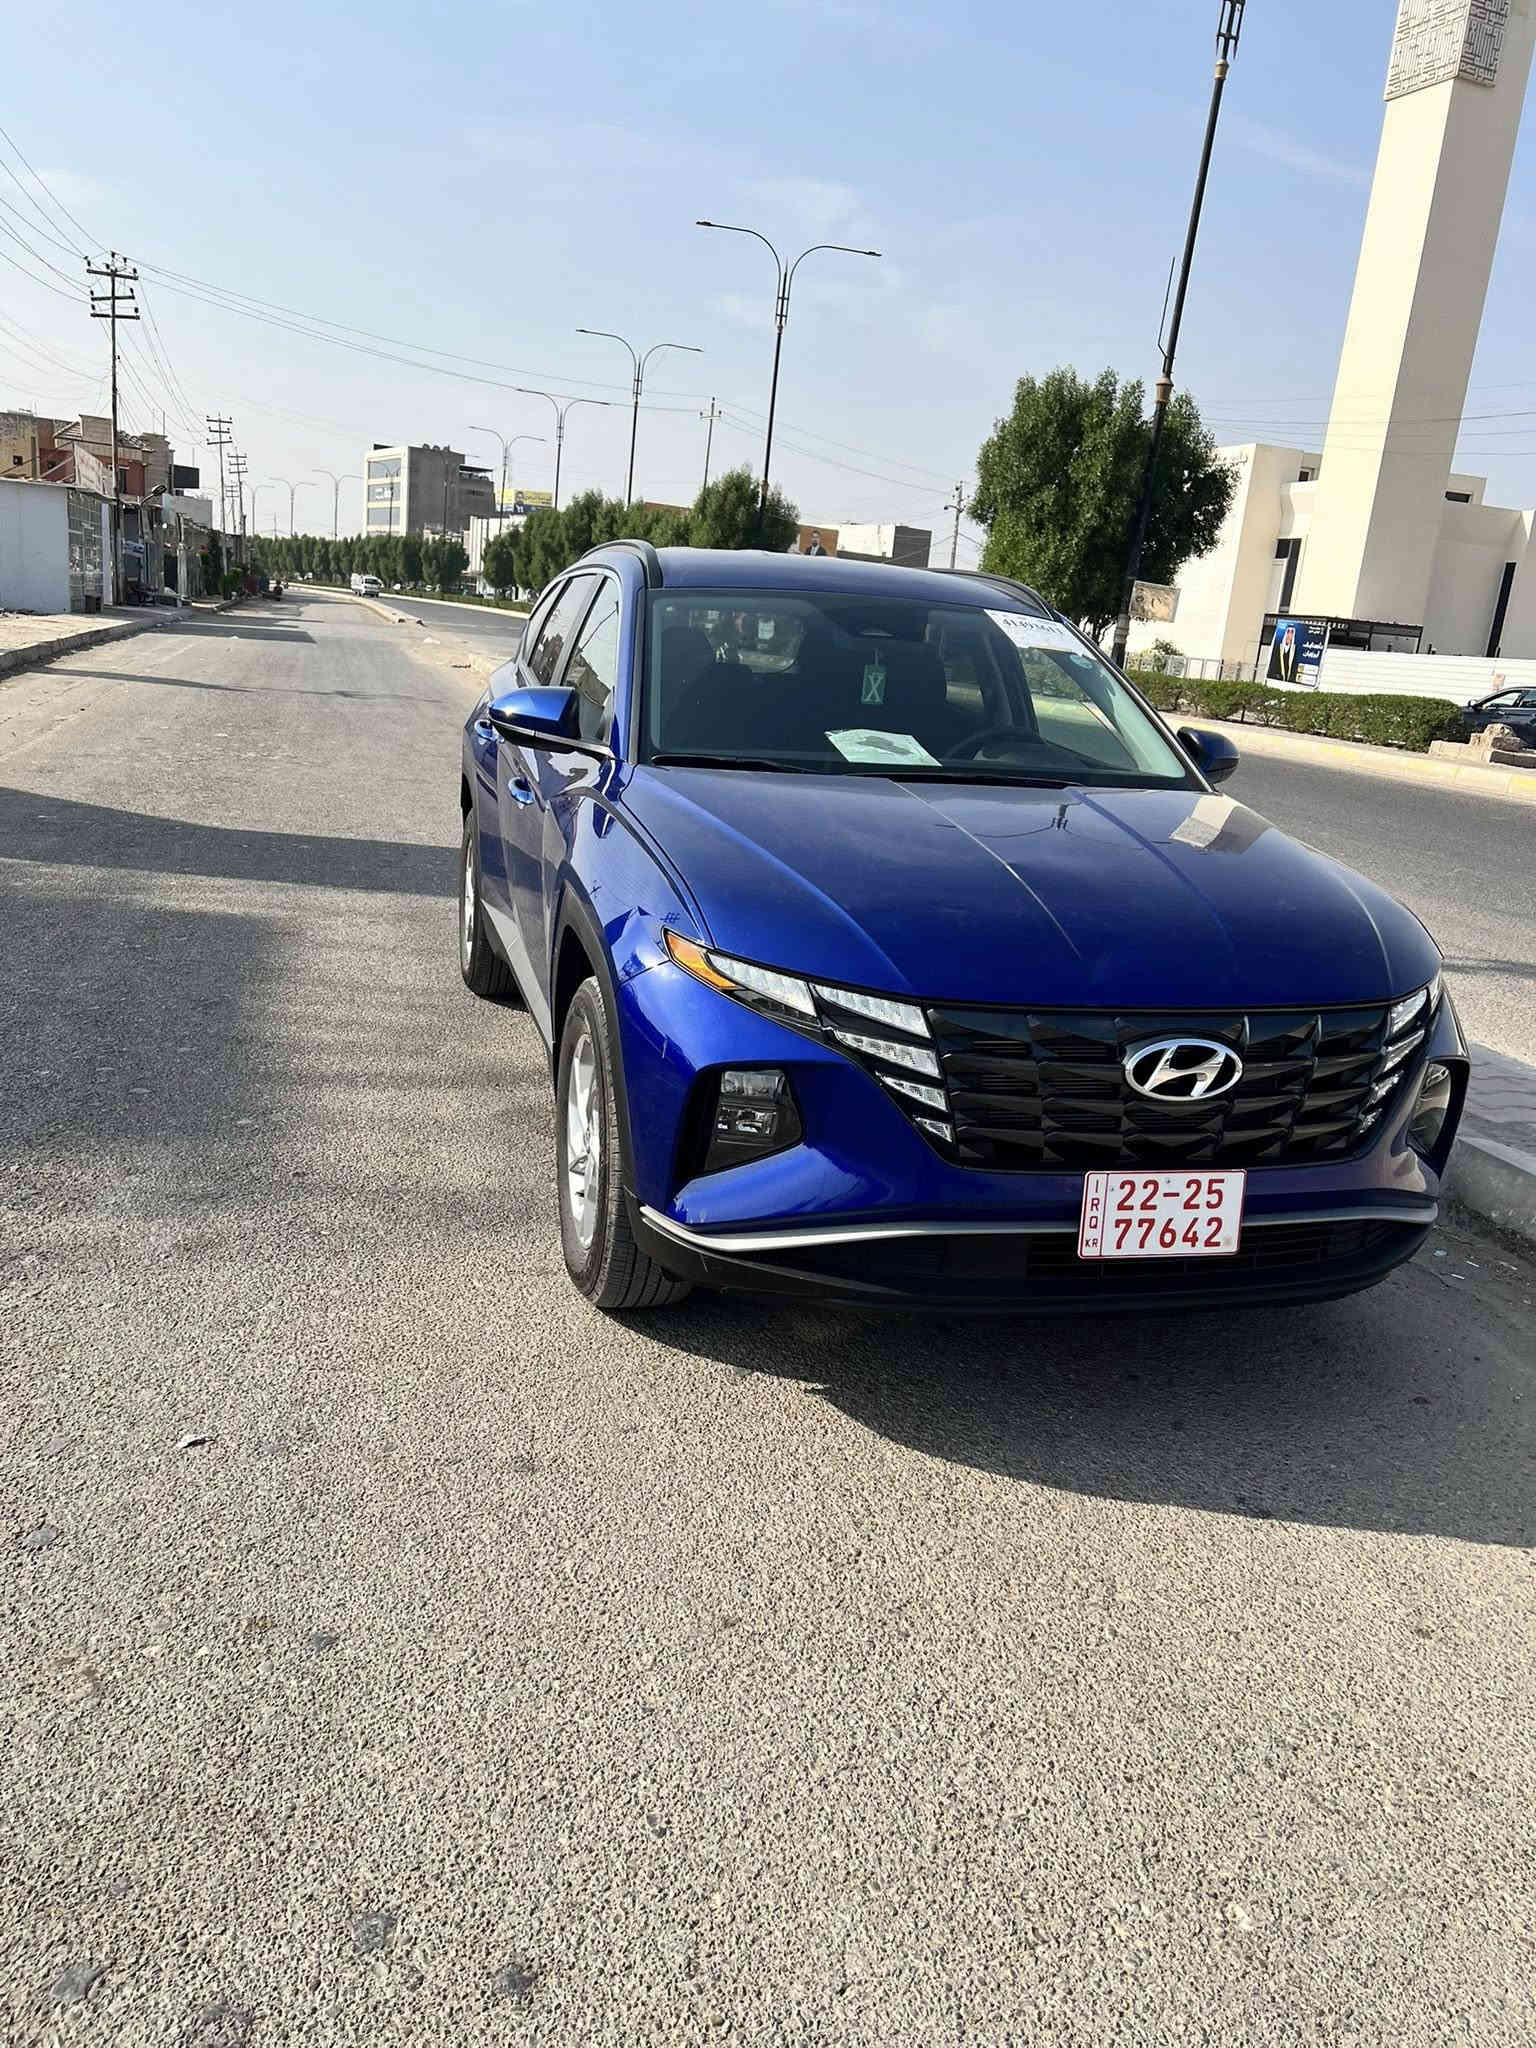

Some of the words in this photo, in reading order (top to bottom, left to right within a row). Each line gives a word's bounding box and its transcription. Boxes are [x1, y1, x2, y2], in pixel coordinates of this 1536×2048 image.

[1116, 1178, 1225, 1211] 22-25
[1085, 1239, 1099, 1248] KR
[1114, 1216, 1223, 1249] 77642
